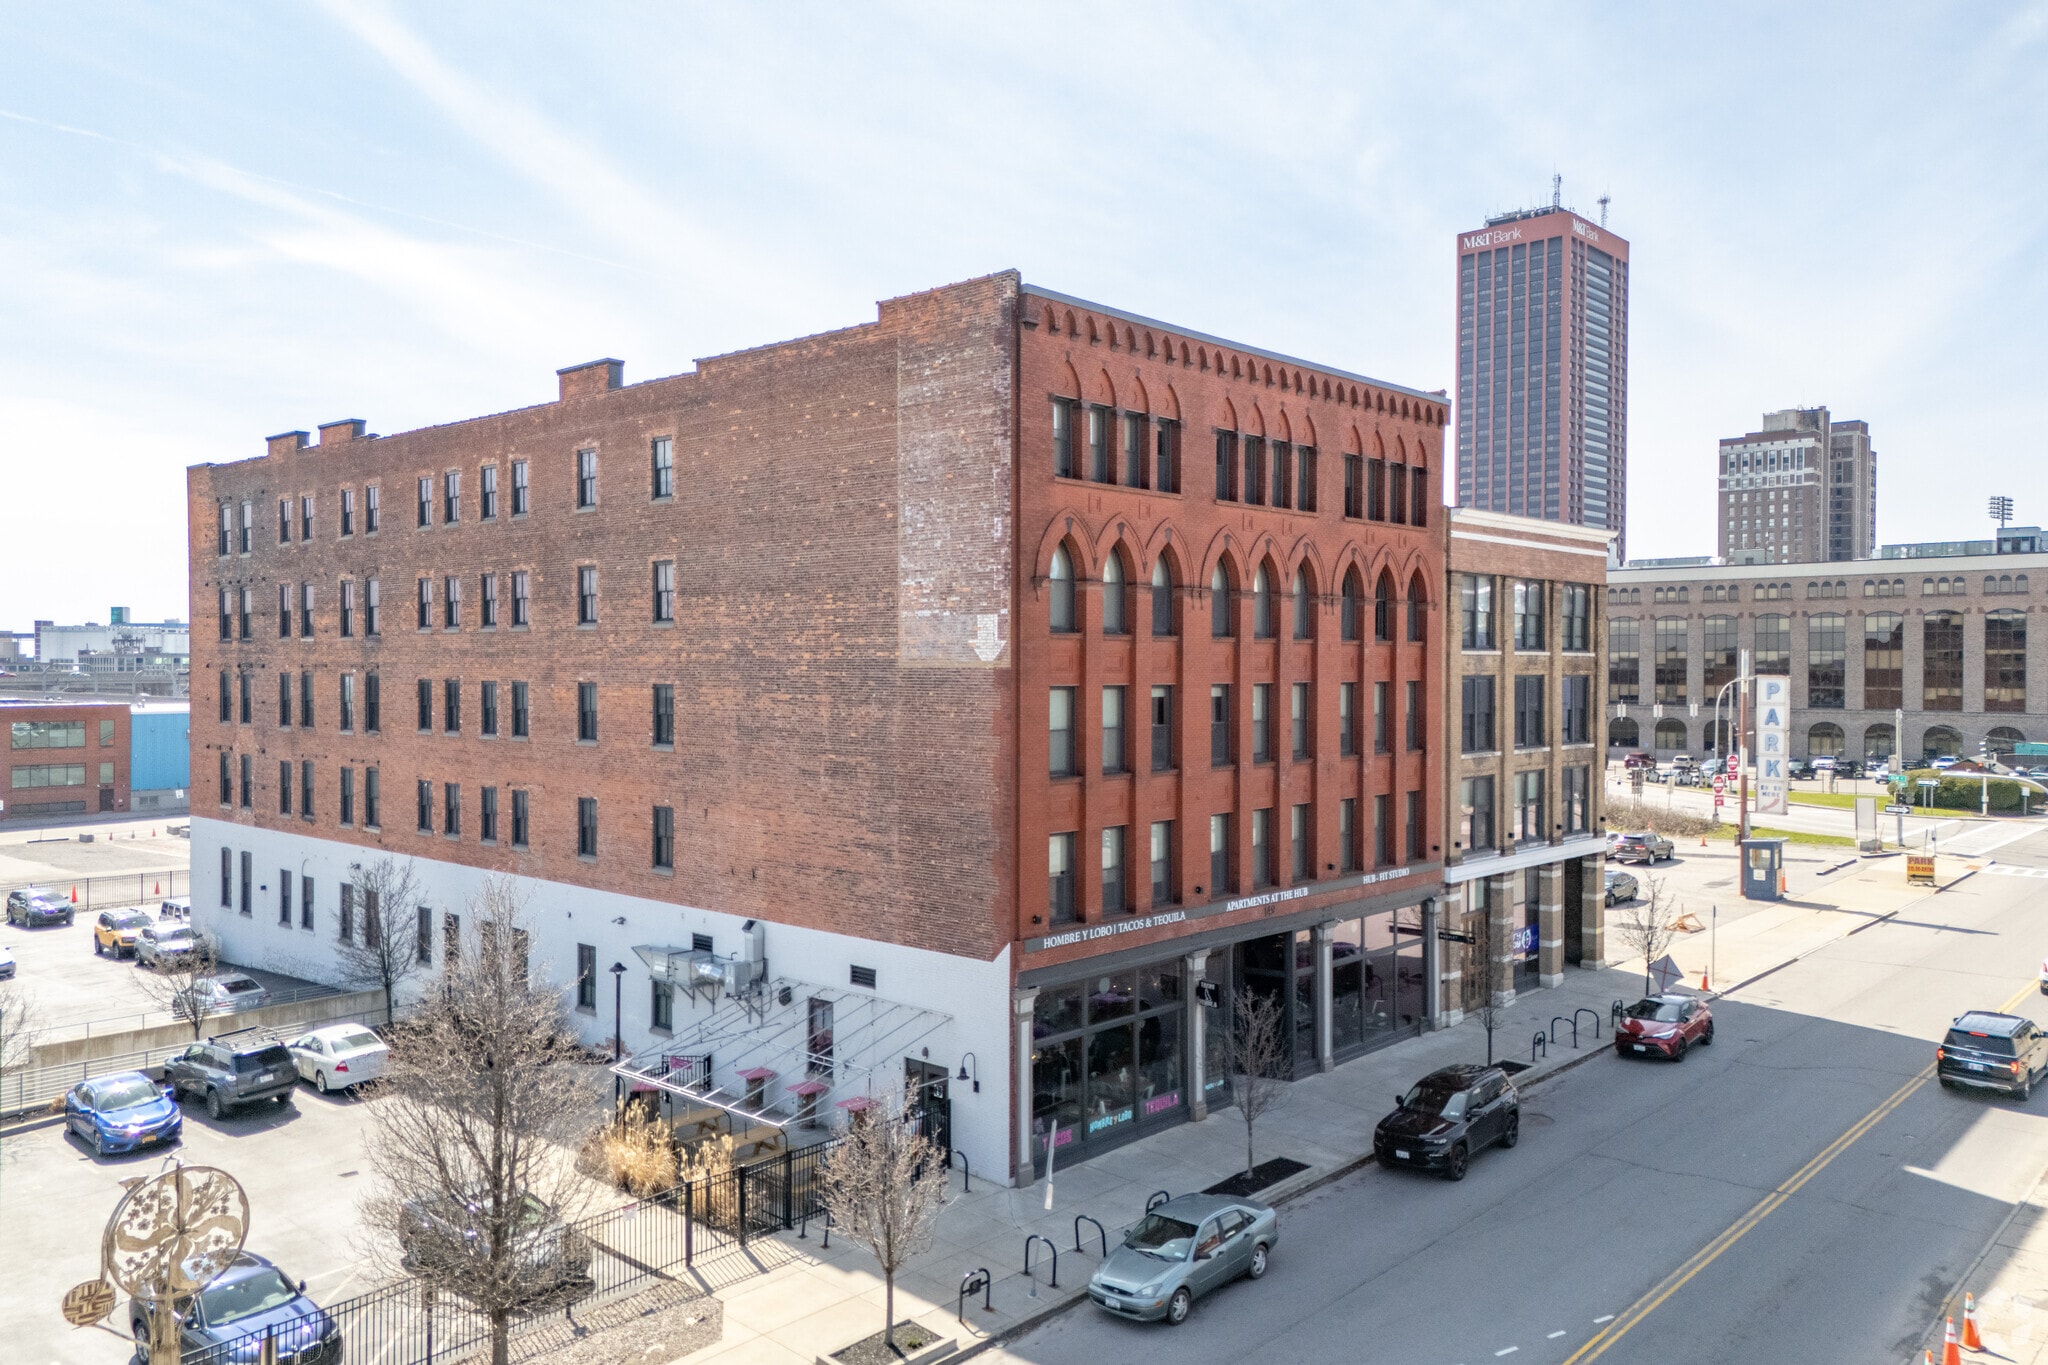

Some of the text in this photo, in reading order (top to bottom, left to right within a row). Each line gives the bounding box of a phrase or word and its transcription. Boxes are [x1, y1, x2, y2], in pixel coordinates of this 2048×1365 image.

[1463, 227, 1522, 250] M&T Bank
[1572, 218, 1599, 243] M&T Bank
[1764, 682, 1781, 778] PARK
[1363, 874, 1376, 885] HUB
[1379, 871, 1389, 882] FIT
[1389, 867, 1410, 880] STUDIO
[1226, 887, 1309, 912] APARTMENTS AT THE HUB
[1043, 931, 1081, 949] HOMBRE
[1082, 930, 1089, 941] Y
[1089, 925, 1112, 939] LOBO
[1118, 919, 1145, 933] TACOS
[1145, 917, 1152, 927] &
[1153, 911, 1186, 927] TEQUILA
[1145, 1092, 1179, 1115] TEQUILA
[1089, 1116, 1114, 1134] HOMBRE
[1118, 1109, 1132, 1123] LOBO
[1042, 1128, 1073, 1152] TCOS
